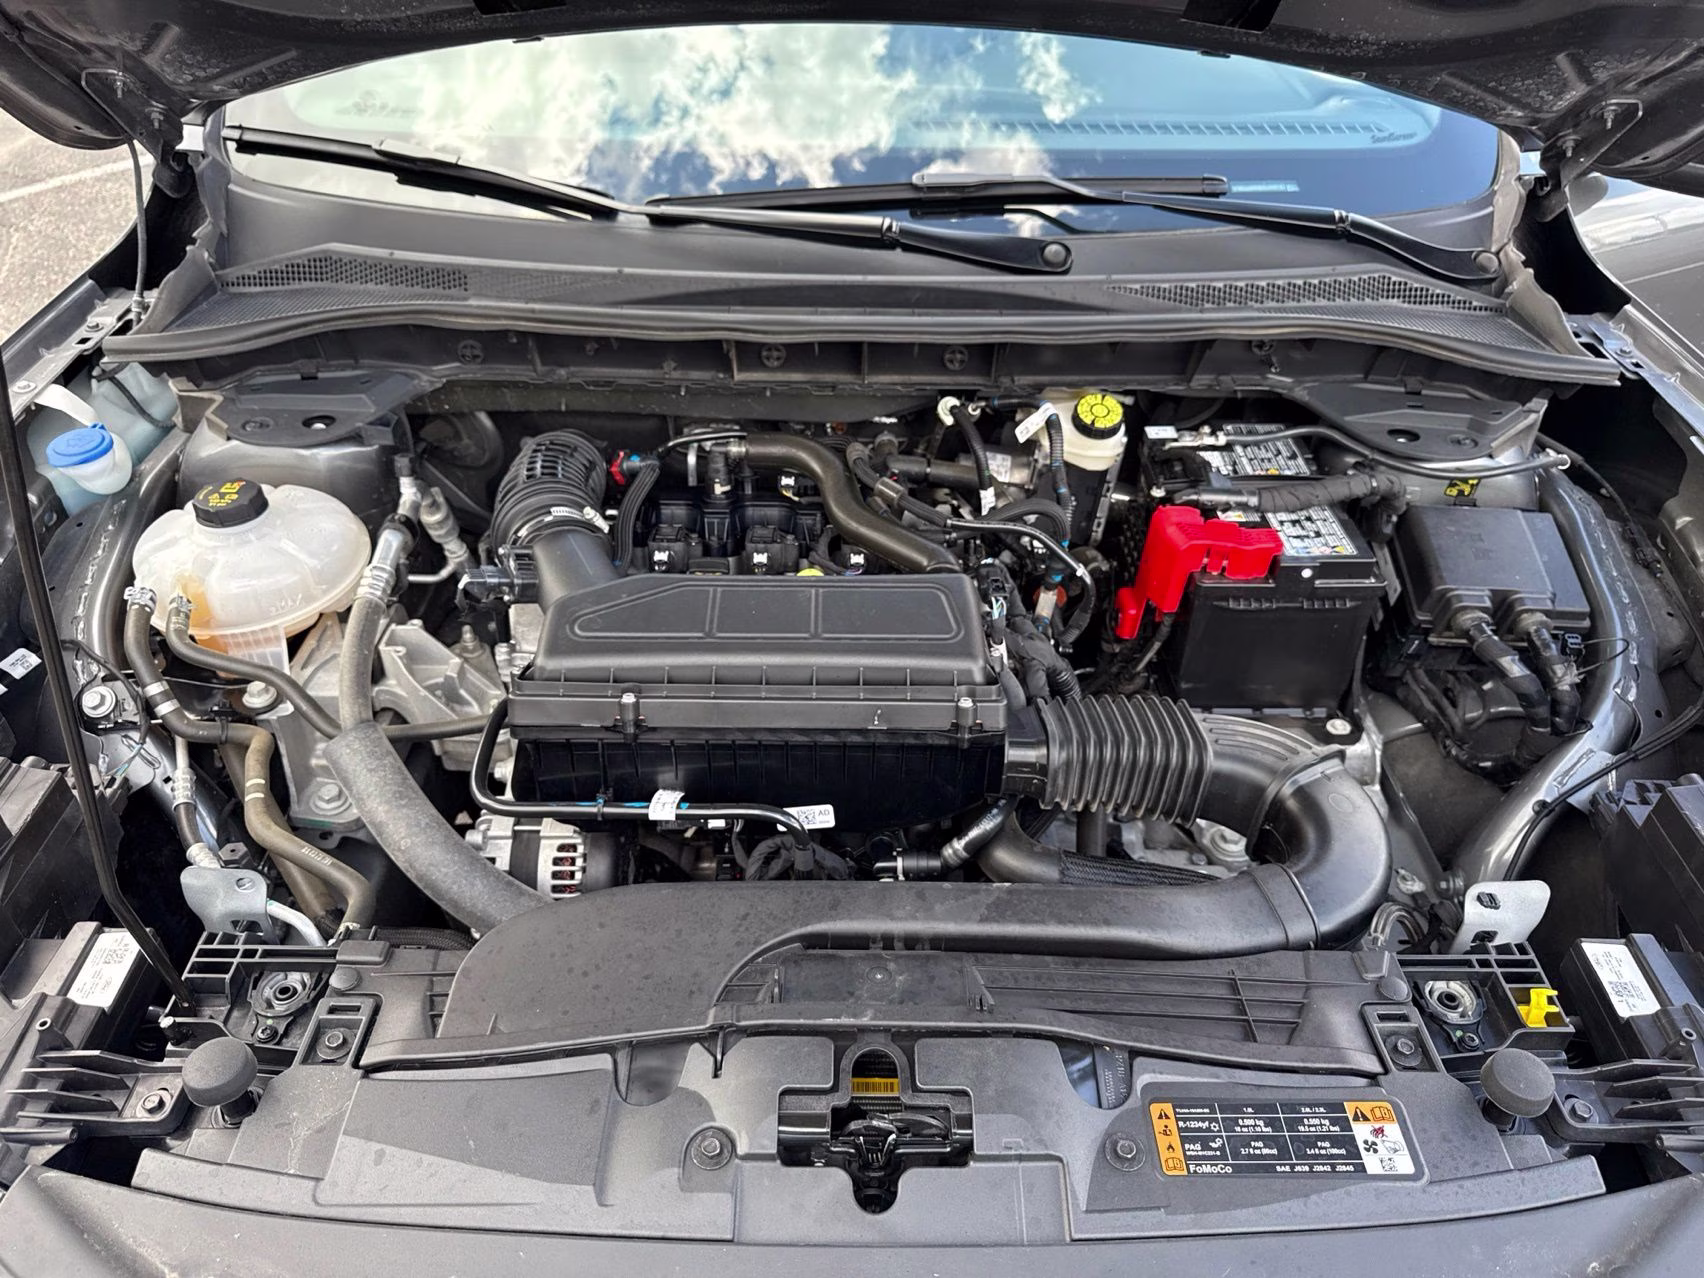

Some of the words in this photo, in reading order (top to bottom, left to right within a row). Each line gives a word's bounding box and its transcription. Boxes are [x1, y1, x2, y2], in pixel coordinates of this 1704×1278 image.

[1177, 1120, 1209, 1130] R-1234yf
[1255, 1118, 1264, 1128] kg
[1320, 1118, 1330, 1126] kg
[1188, 1164, 1233, 1174] FoMoCo
